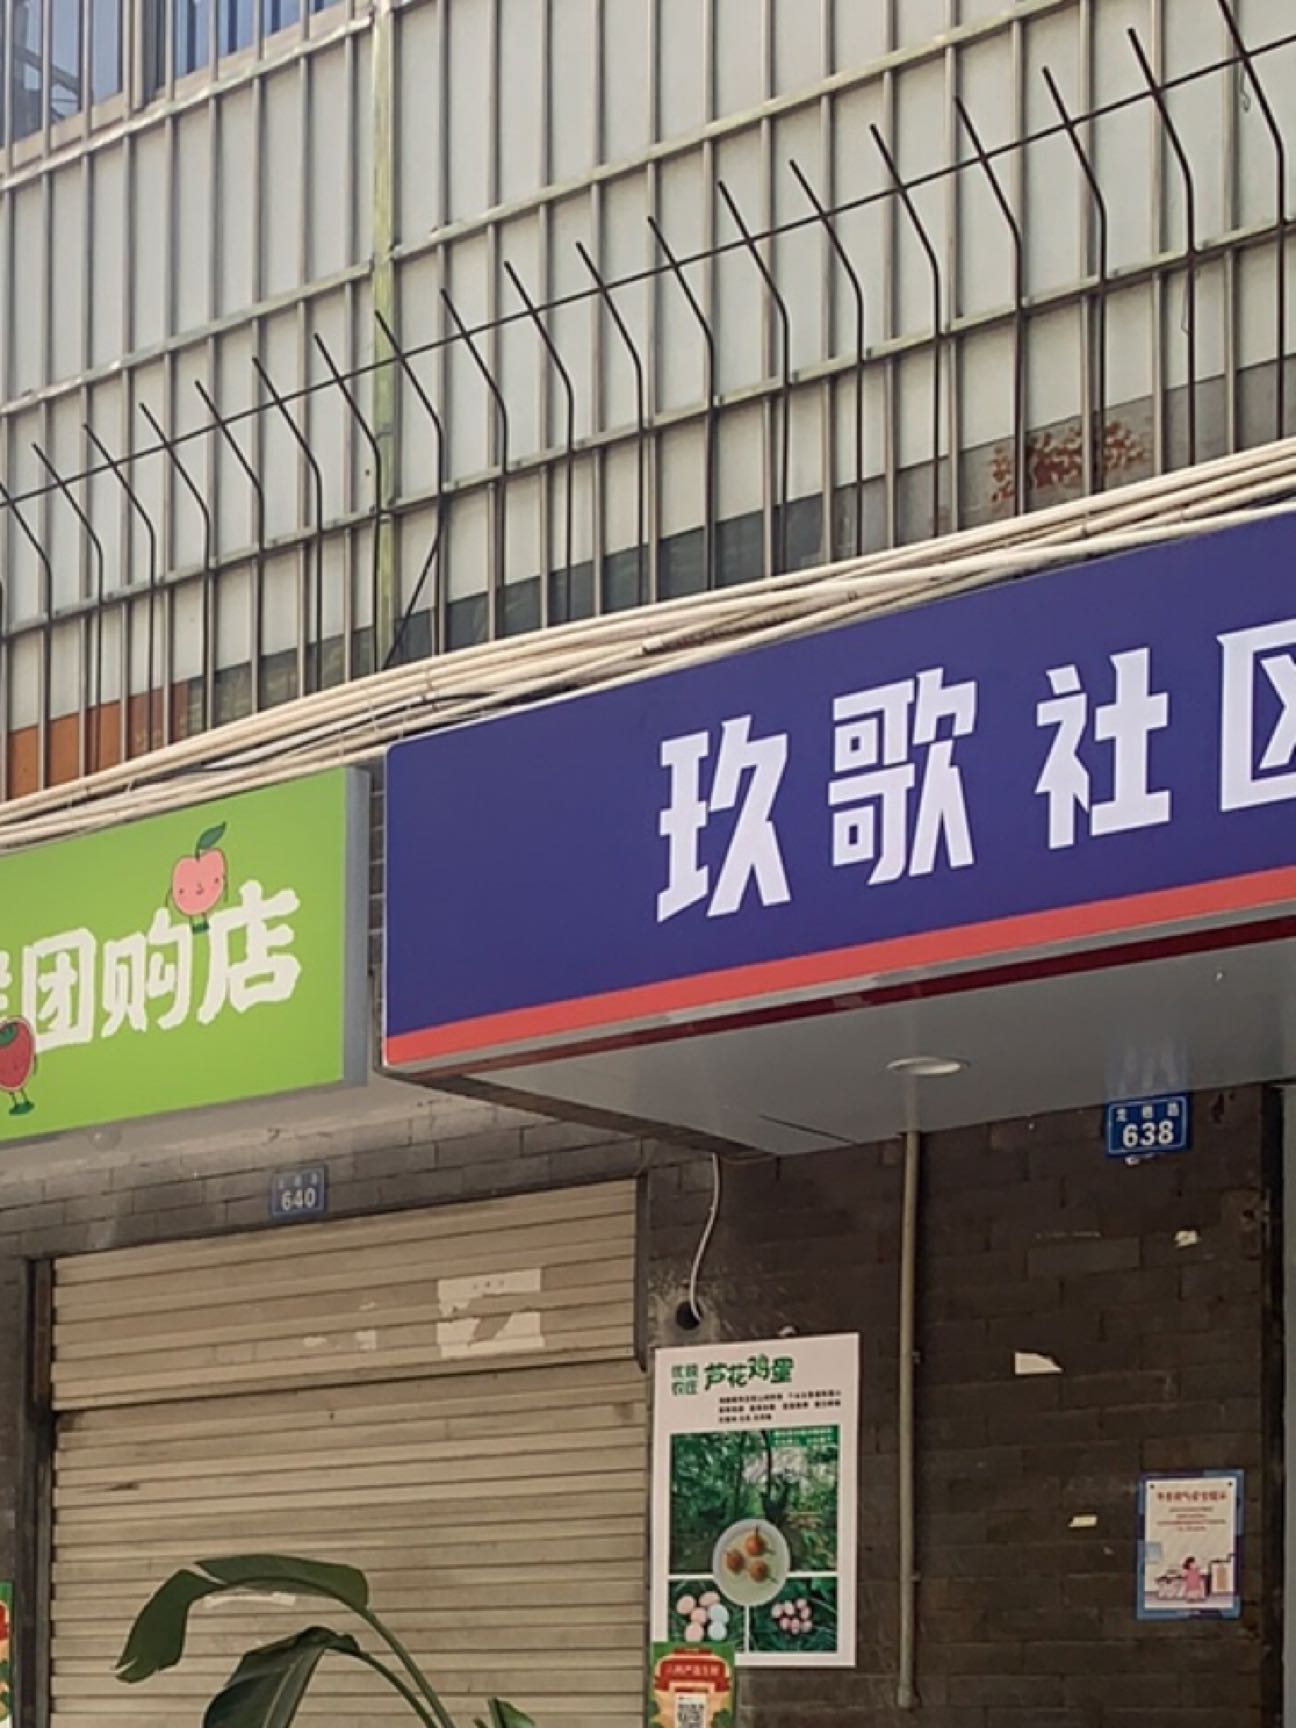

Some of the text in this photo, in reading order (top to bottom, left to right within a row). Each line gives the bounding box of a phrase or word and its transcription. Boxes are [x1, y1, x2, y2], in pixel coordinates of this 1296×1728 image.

[655, 616, 1296, 924] 玖歌社区
[1122, 1120, 1174, 1148] 638
[281, 1187, 316, 1211] 640
[704, 1352, 795, 1392] 芦花鸡蛋
